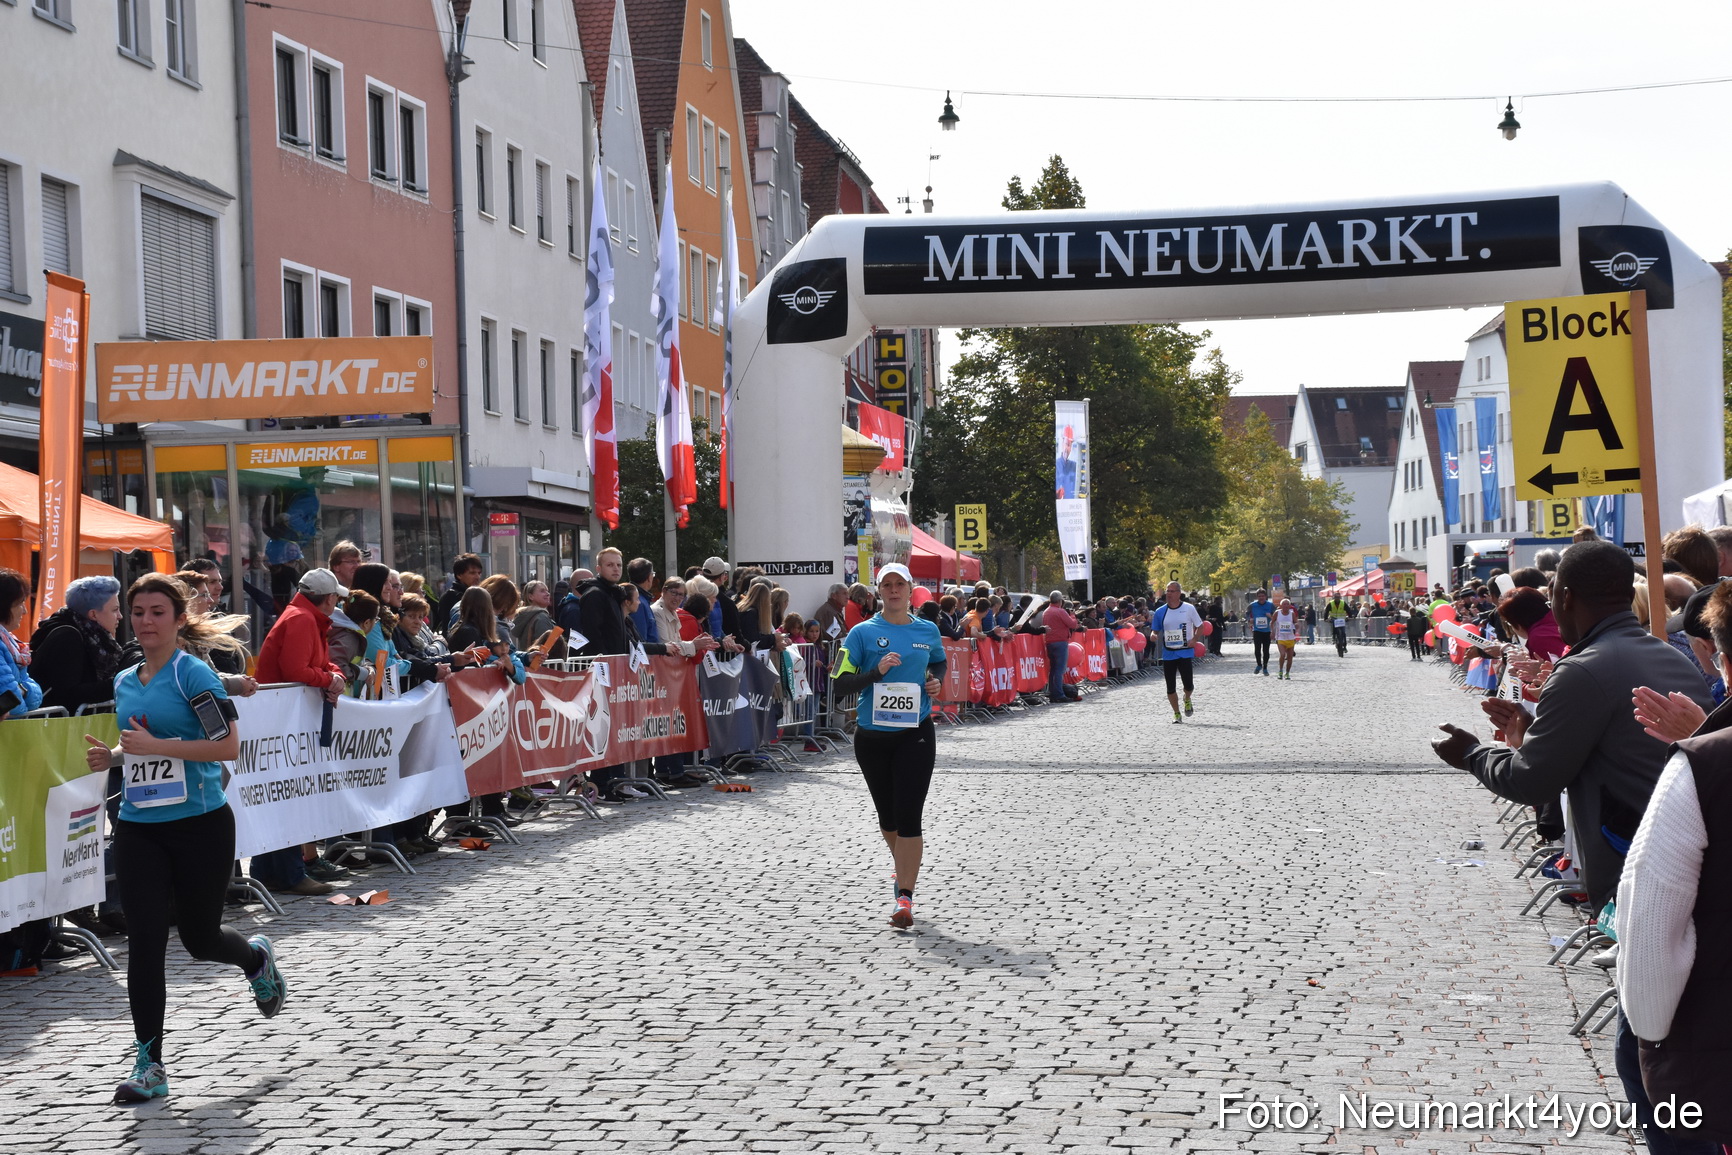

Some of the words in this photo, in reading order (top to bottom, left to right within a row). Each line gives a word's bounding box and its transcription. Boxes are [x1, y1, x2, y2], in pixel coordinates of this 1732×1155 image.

[923, 232, 1076, 282] MINI
[1095, 212, 1491, 278] NEUMARKT.
[1613, 262, 1637, 271] MINI
[796, 296, 816, 304] MINI
[1522, 301, 1631, 342] Block
[109, 358, 417, 402] RUNMARKT.DE
[1542, 356, 1625, 455] A
[250, 446, 367, 464] RUNMARKT.DE
[959, 506, 983, 515] Block
[1552, 503, 1570, 527] B
[964, 519, 979, 541] B
[1169, 569, 1179, 581] C
[1466, 631, 1484, 644] swn
[880, 695, 914, 711] 2265
[460, 722, 486, 761] DAS
[131, 759, 174, 783] 2172
[144, 787, 158, 796] Lisa
